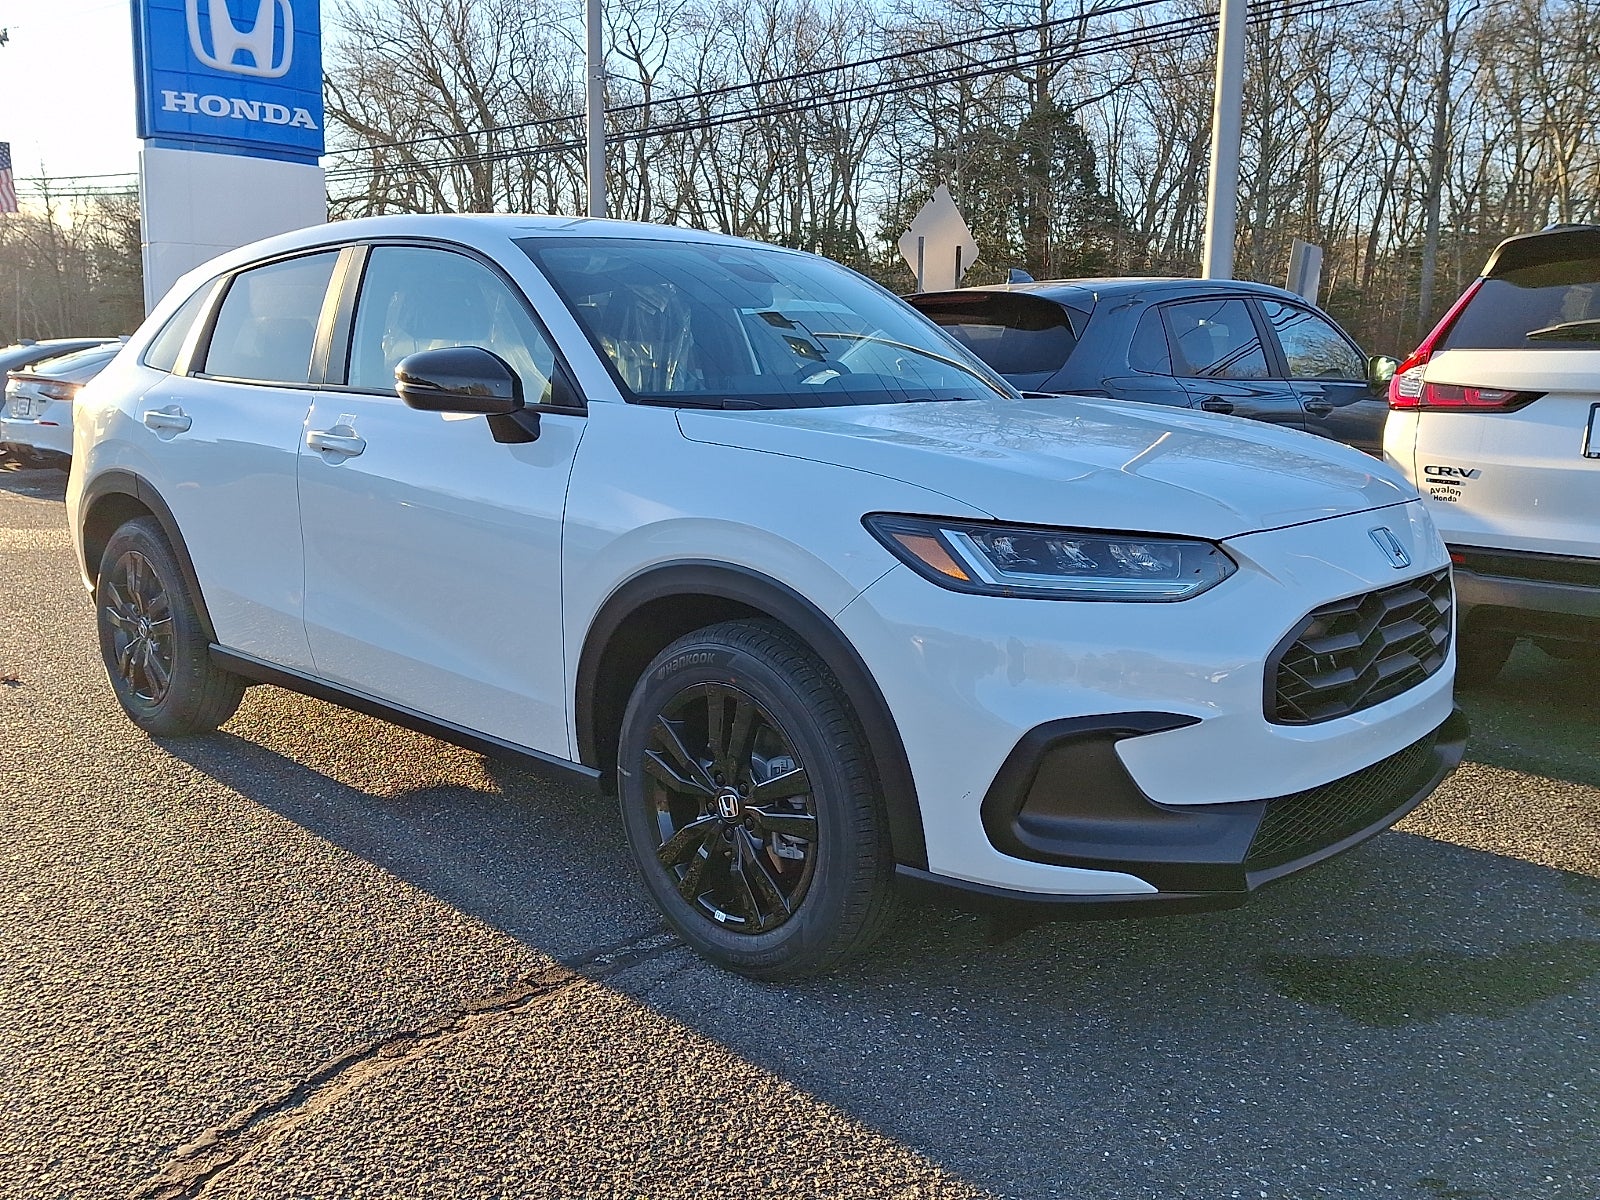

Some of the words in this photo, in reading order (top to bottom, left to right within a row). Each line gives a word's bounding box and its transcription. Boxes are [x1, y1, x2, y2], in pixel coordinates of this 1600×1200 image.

[161, 90, 318, 129] HONDA
[1424, 465, 1481, 479] CR-V
[1430, 486, 1461, 497] Avalon
[1433, 495, 1457, 503] Honda
